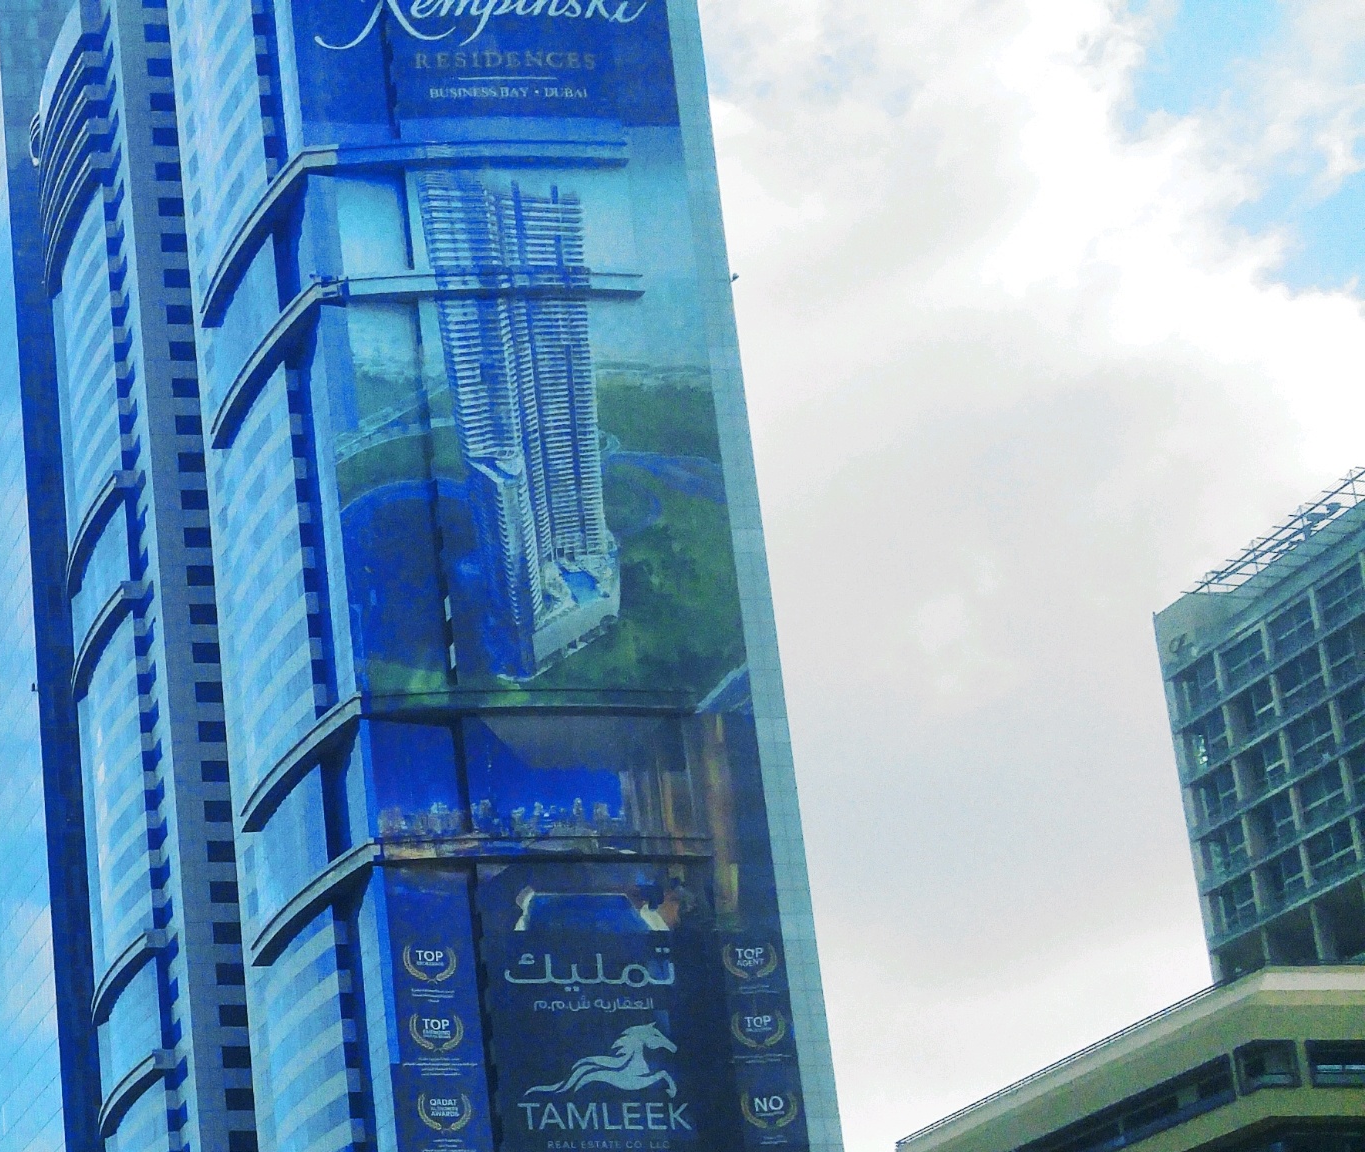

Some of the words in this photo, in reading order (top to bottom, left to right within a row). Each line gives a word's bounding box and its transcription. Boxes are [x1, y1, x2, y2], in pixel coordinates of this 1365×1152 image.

[415, 50, 597, 70] RESIDENCES
[429, 87, 497, 99] BUSINESS
[500, 86, 529, 98] BAY
[544, 86, 588, 98] DUBAI
[416, 950, 444, 961] TOP
[736, 947, 764, 960] TOP
[504, 947, 675, 988] تمليك
[736, 958, 764, 967] AGENT
[422, 1018, 450, 1030] TOP
[744, 1015, 772, 1028] TOP
[753, 1095, 784, 1112] NO
[517, 1102, 693, 1131] TAMLEEK
[547, 1140, 577, 1149] REAL
[580, 1140, 622, 1149] ESTATE
[649, 1140, 670, 1149] LLC
